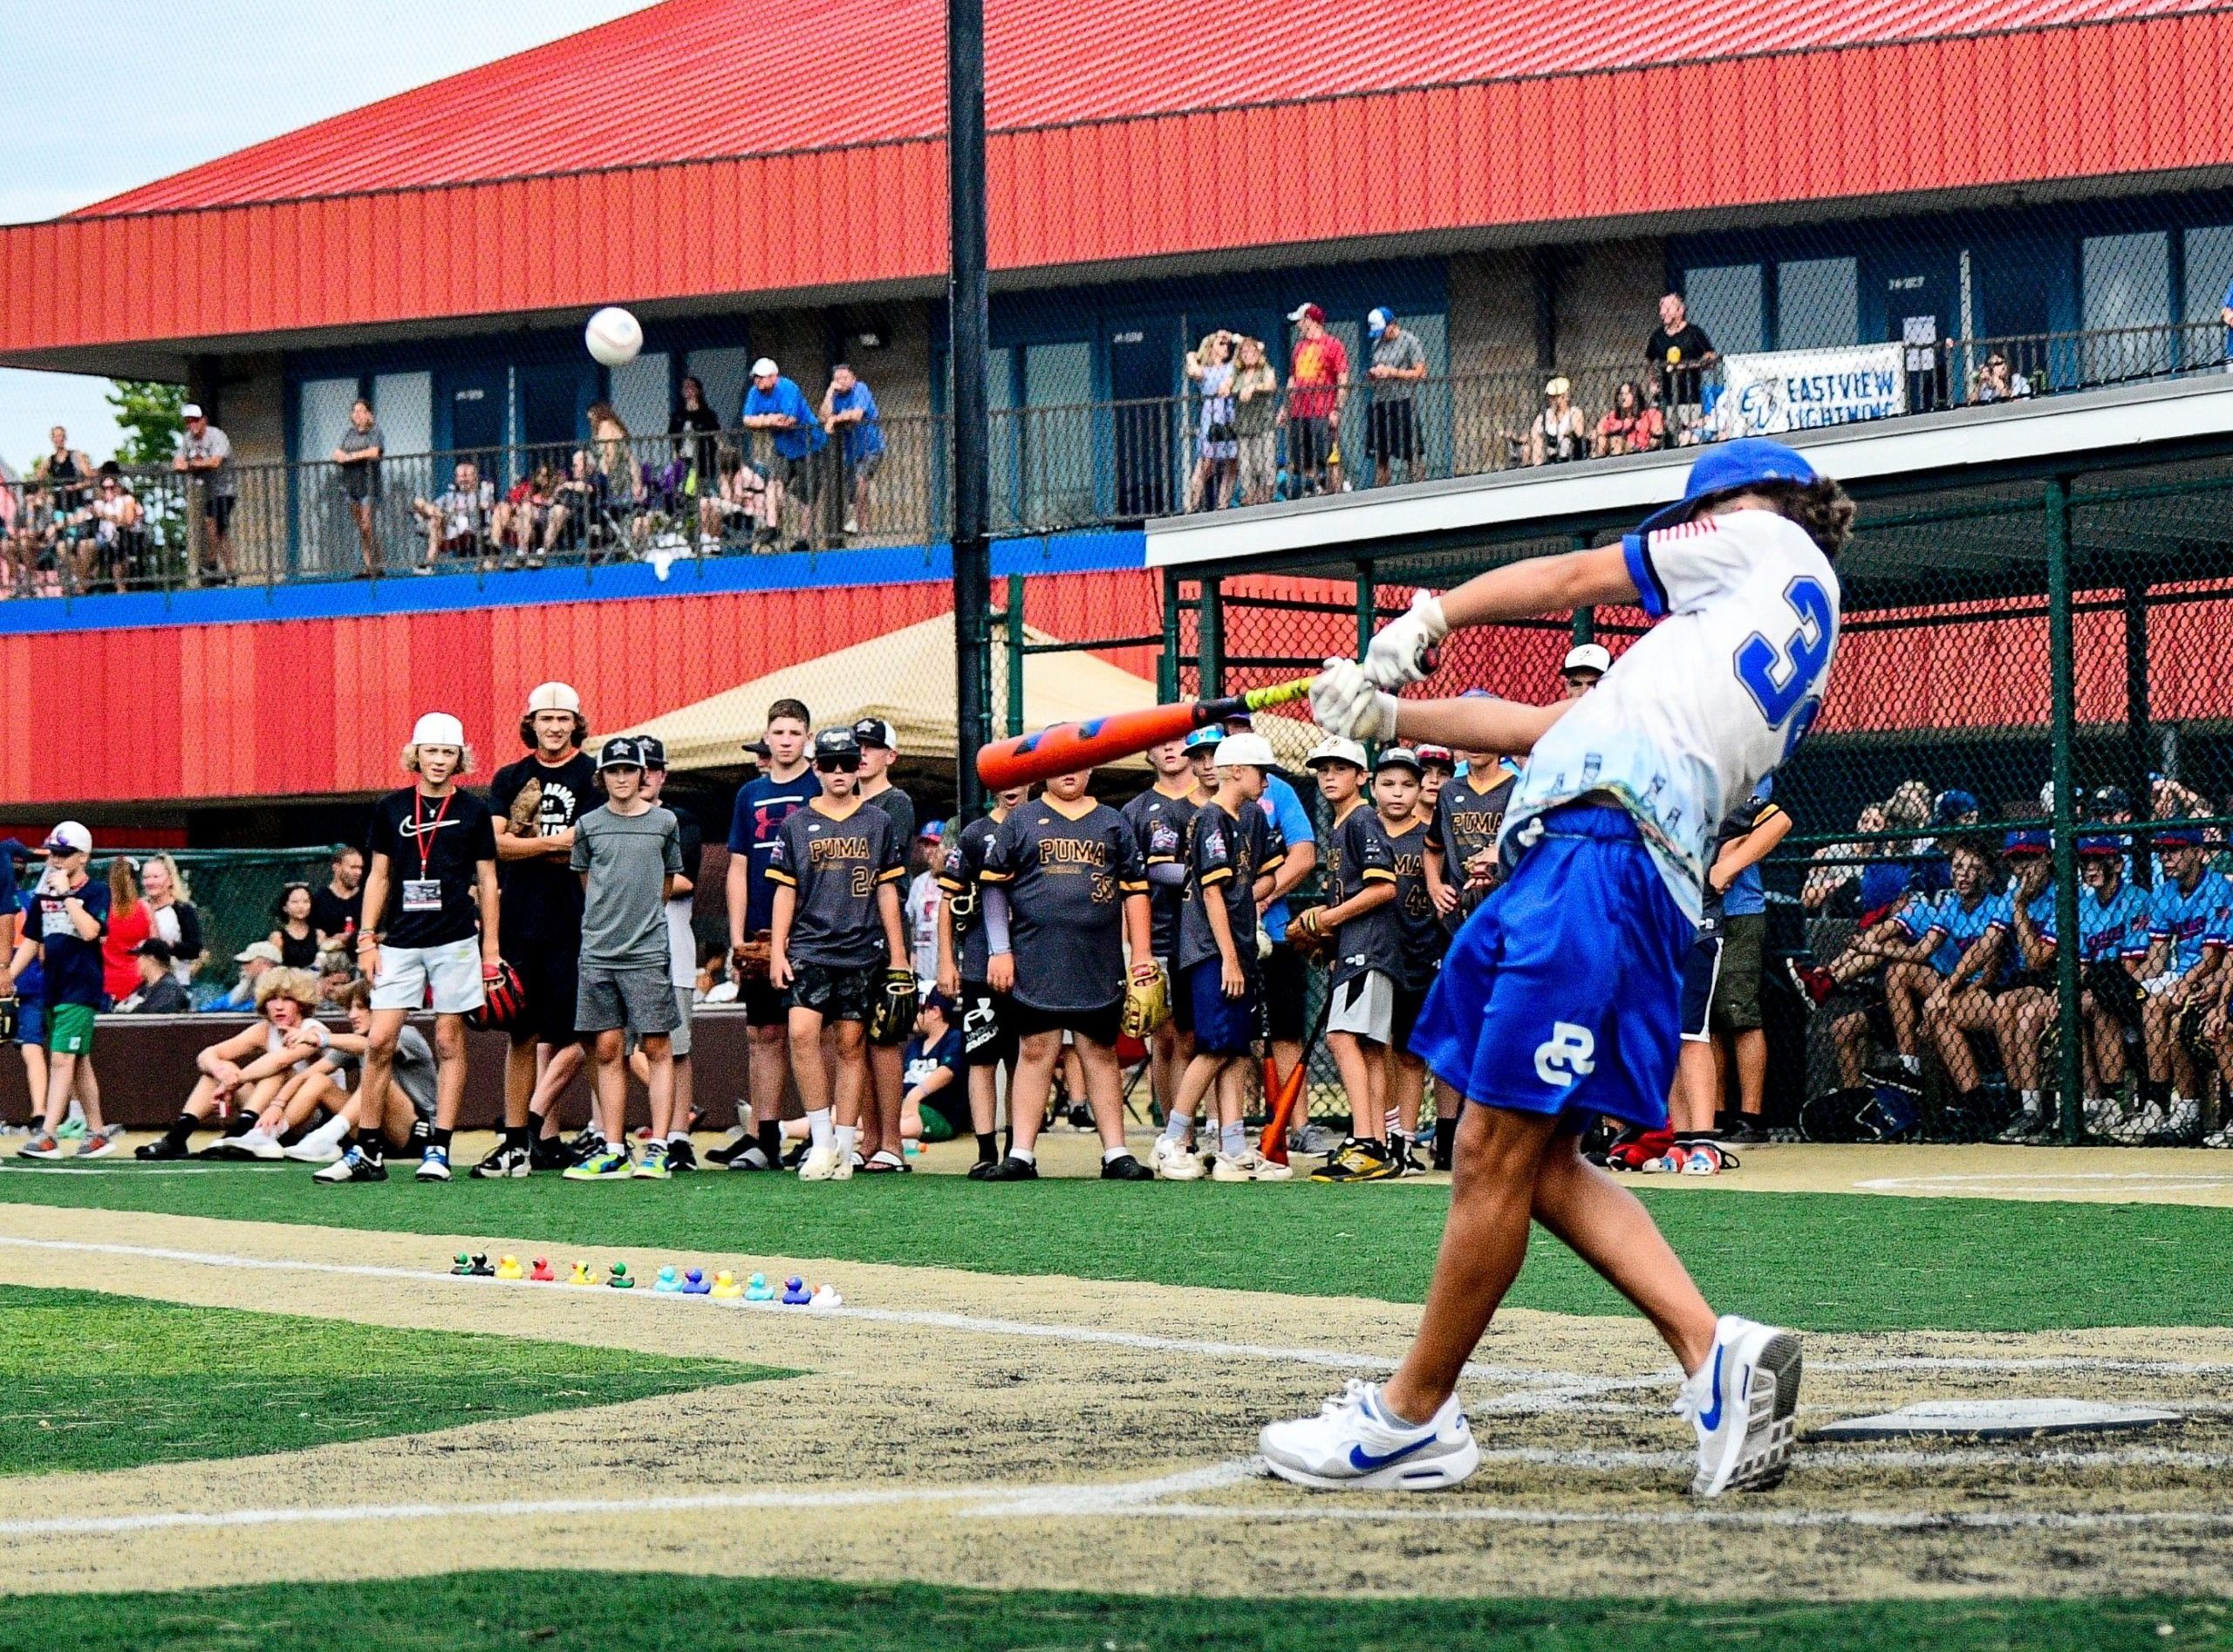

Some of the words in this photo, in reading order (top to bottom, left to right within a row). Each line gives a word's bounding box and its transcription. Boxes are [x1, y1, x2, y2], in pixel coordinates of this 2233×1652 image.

[1787, 369, 1894, 403] EASTVIEW
[1451, 811, 1505, 836] PUMA
[809, 837, 871, 863] PUMA
[1039, 838, 1105, 868] PUMA
[1395, 853, 1424, 877] MA
